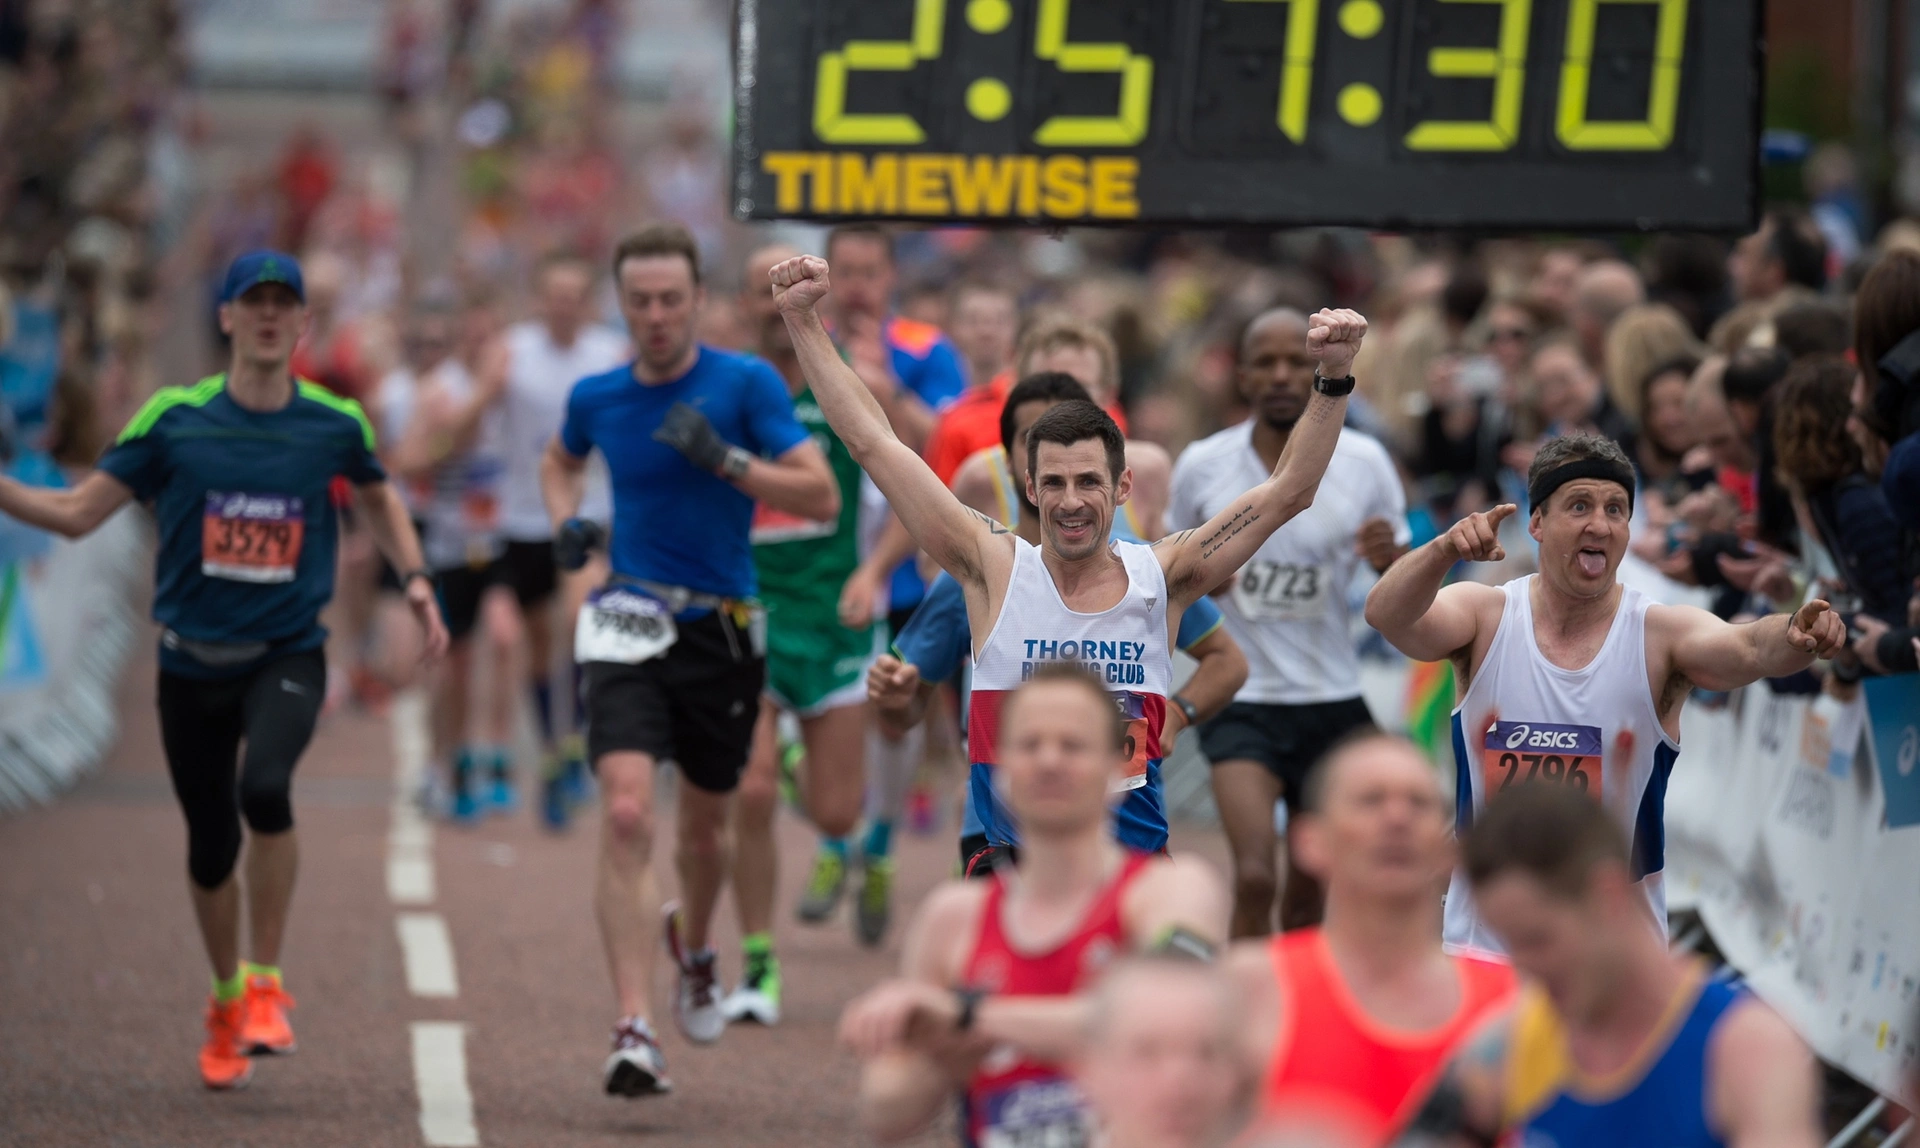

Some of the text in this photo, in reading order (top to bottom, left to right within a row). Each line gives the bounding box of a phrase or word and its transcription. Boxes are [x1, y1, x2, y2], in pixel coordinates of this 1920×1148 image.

[761, 151, 1139, 219] TIMEWISE
[1242, 562, 1317, 600] 6723
[1023, 639, 1146, 662] THORNEY
[1021, 661, 1145, 684] RUNG CLUB
[1528, 730, 1579, 749] asics
[1498, 753, 1588, 794] 2796
